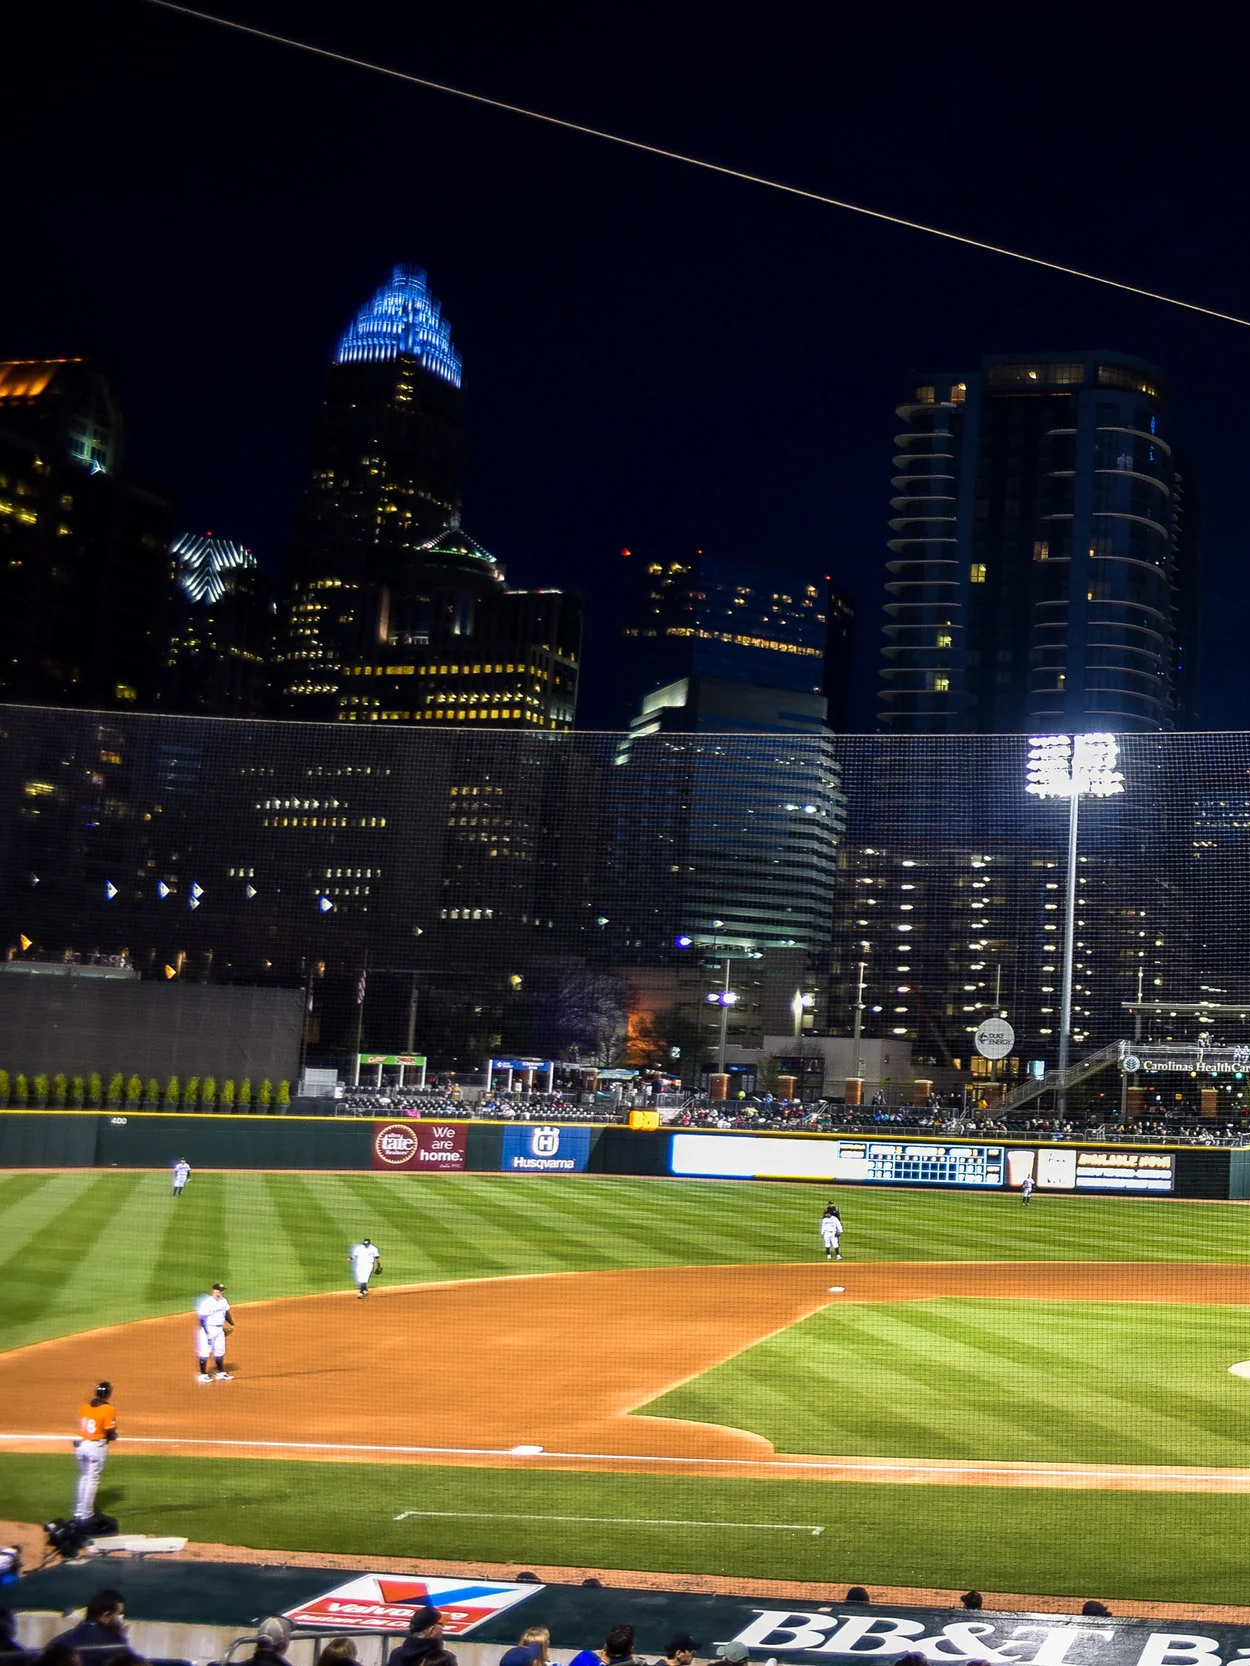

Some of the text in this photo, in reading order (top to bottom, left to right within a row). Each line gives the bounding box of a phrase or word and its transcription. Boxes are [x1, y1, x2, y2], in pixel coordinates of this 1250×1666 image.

[1143, 1061, 1194, 1072] Carolinas
[111, 1117, 128, 1125] 400
[432, 1126, 455, 1138] We
[381, 1134, 414, 1150] tate
[431, 1140, 453, 1149] are
[420, 1149, 463, 1161] home.
[513, 1157, 574, 1169] Husqvarna
[328, 1602, 469, 1620] Valvoe
[713, 1609, 1115, 1666] BB&T
